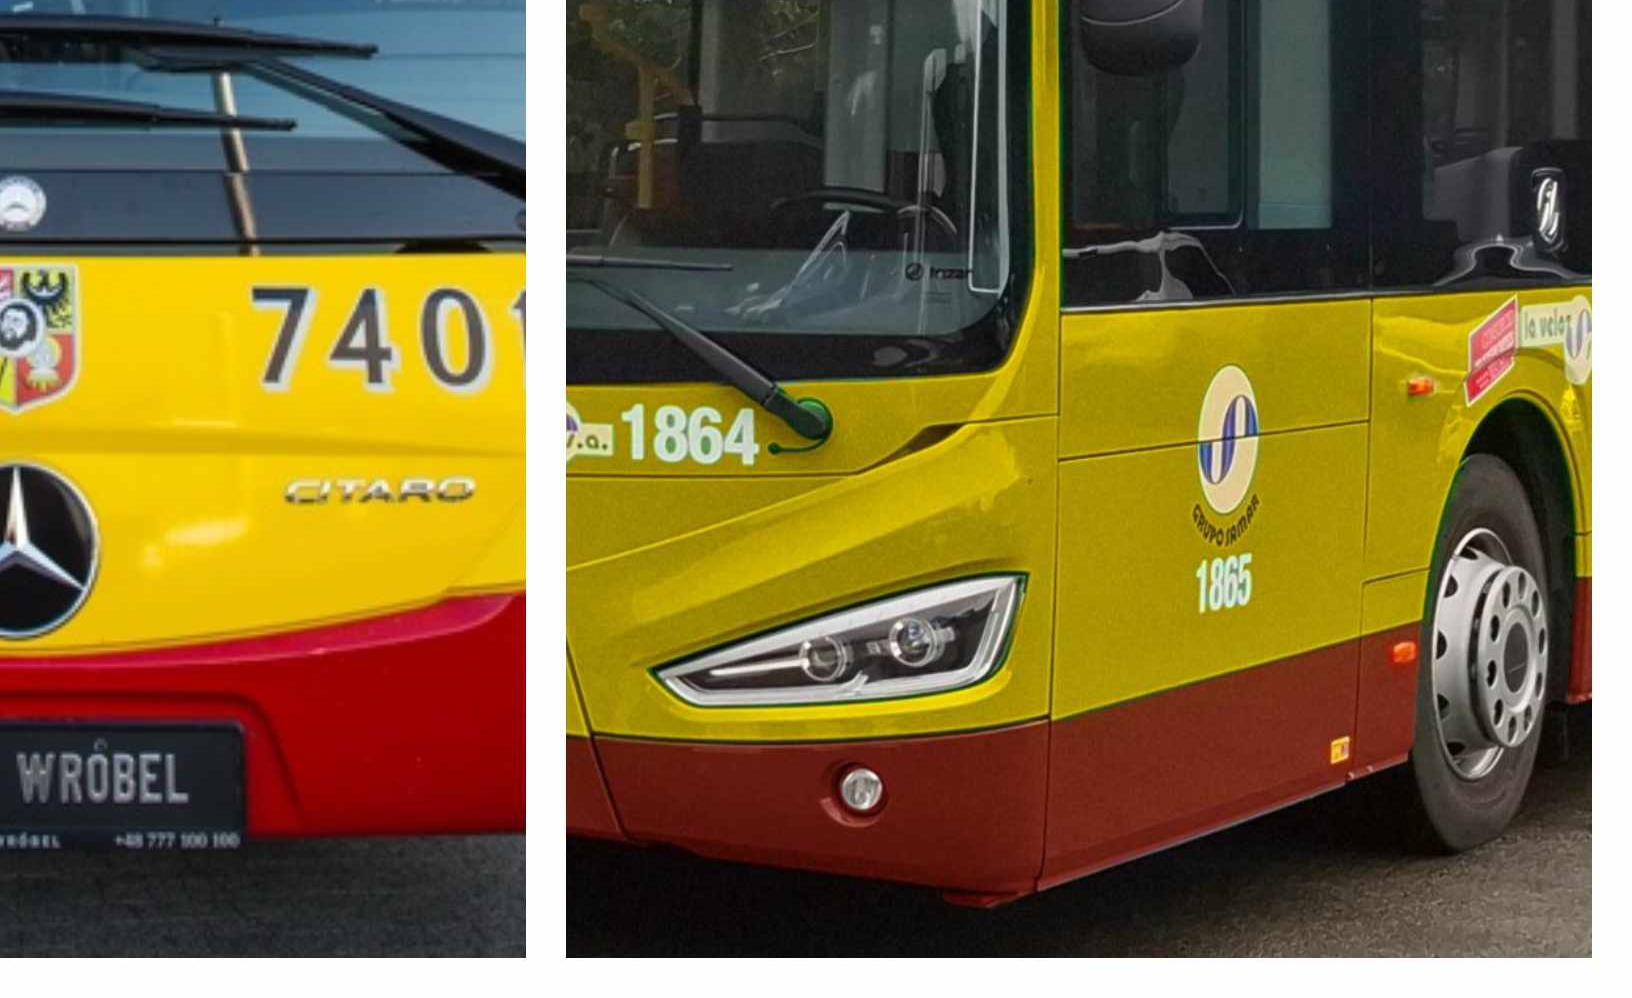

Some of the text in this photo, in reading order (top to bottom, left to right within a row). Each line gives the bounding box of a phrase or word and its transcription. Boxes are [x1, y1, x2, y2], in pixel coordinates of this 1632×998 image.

[621, 404, 761, 466] 1864
[283, 476, 477, 504] CITARO
[1192, 503, 1224, 547] GRUPO
[1196, 553, 1253, 614] 1865
[146, 831, 176, 849] 777
